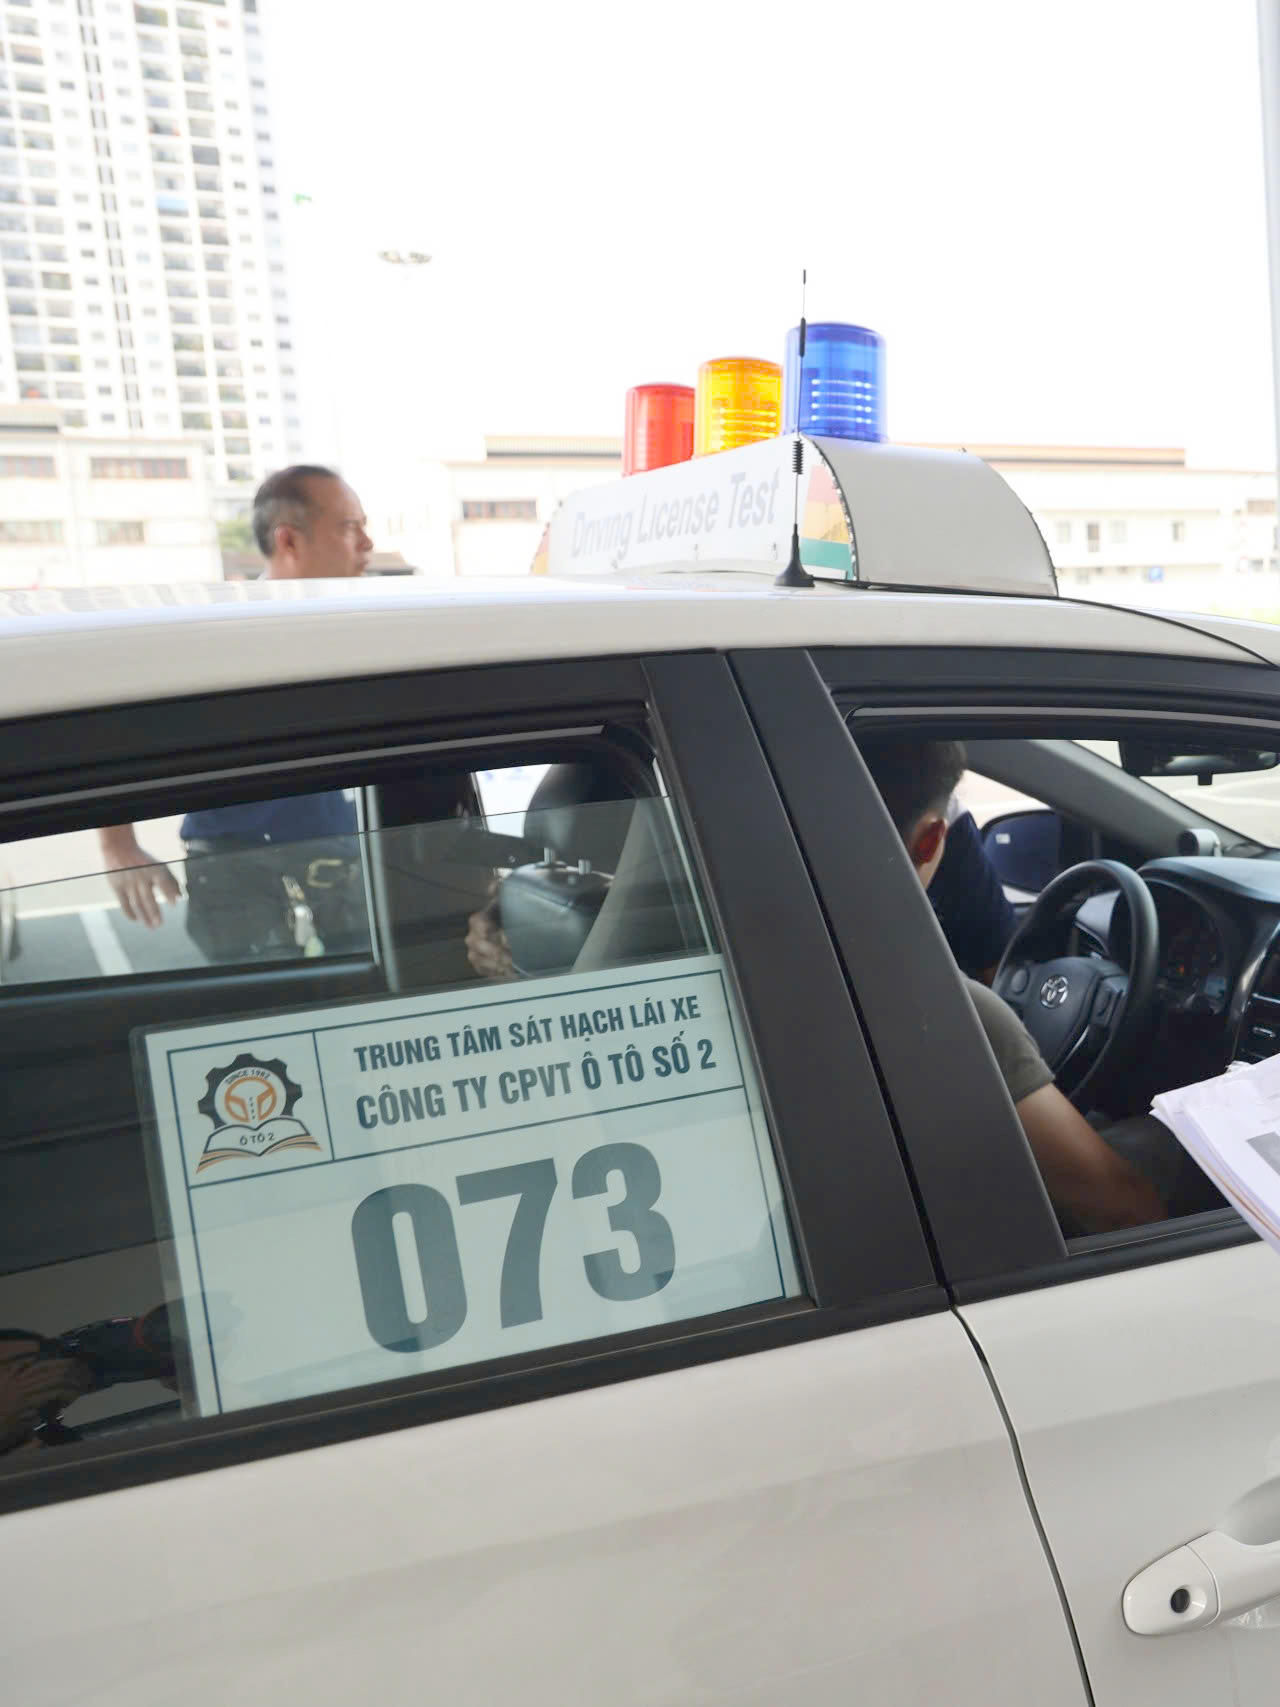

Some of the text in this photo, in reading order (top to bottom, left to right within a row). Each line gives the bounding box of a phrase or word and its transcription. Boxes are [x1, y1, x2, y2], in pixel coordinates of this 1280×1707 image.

[571, 465, 780, 561] Driving License Test
[353, 995, 701, 1072] TRUNG TÂM SÁT HẠCH LÁI XE
[356, 1030, 717, 1130] CÔNG TY CPVT Ô TÔ SỐ 2
[351, 1142, 676, 1354] 073
